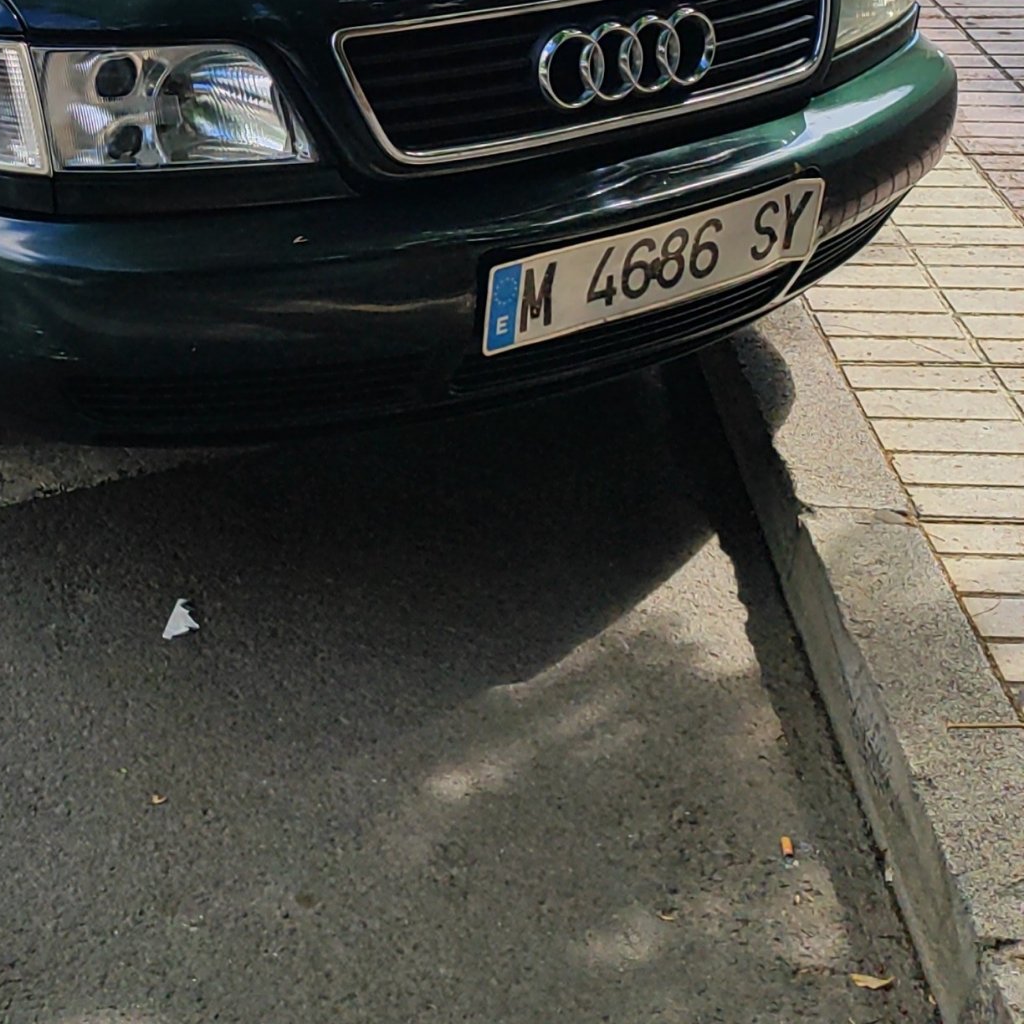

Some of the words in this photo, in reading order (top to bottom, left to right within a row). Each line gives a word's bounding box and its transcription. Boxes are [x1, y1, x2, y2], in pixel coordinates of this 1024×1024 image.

[519, 261, 557, 333] M
[586, 217, 723, 306] 4686
[750, 190, 813, 260] SY
[496, 315, 508, 335] E
